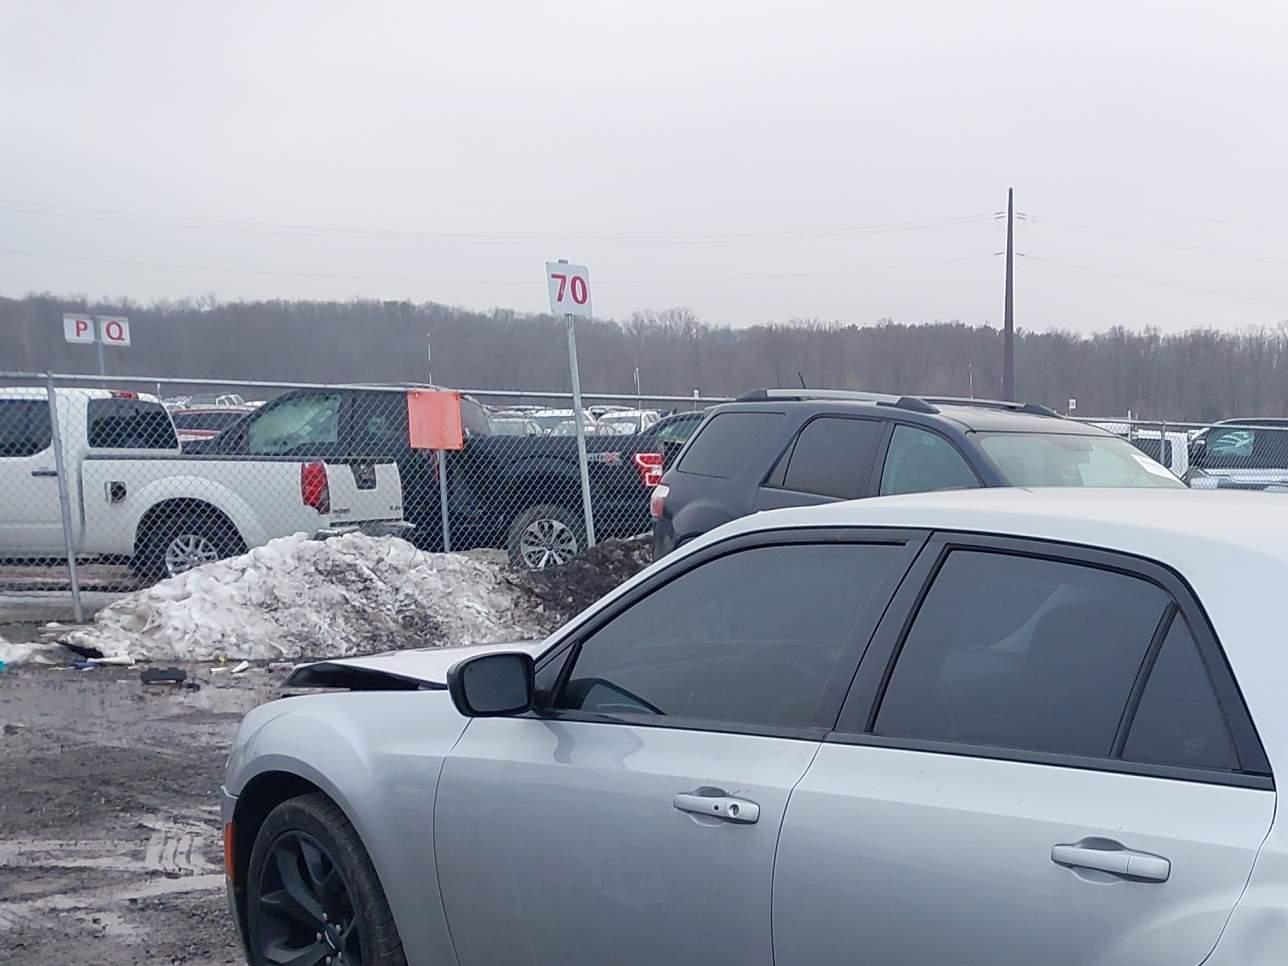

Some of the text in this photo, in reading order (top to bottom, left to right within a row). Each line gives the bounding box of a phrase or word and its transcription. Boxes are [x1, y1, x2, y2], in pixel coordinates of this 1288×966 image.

[551, 273, 588, 305] 70
[75, 320, 88, 338] P
[105, 320, 126, 341] Q
